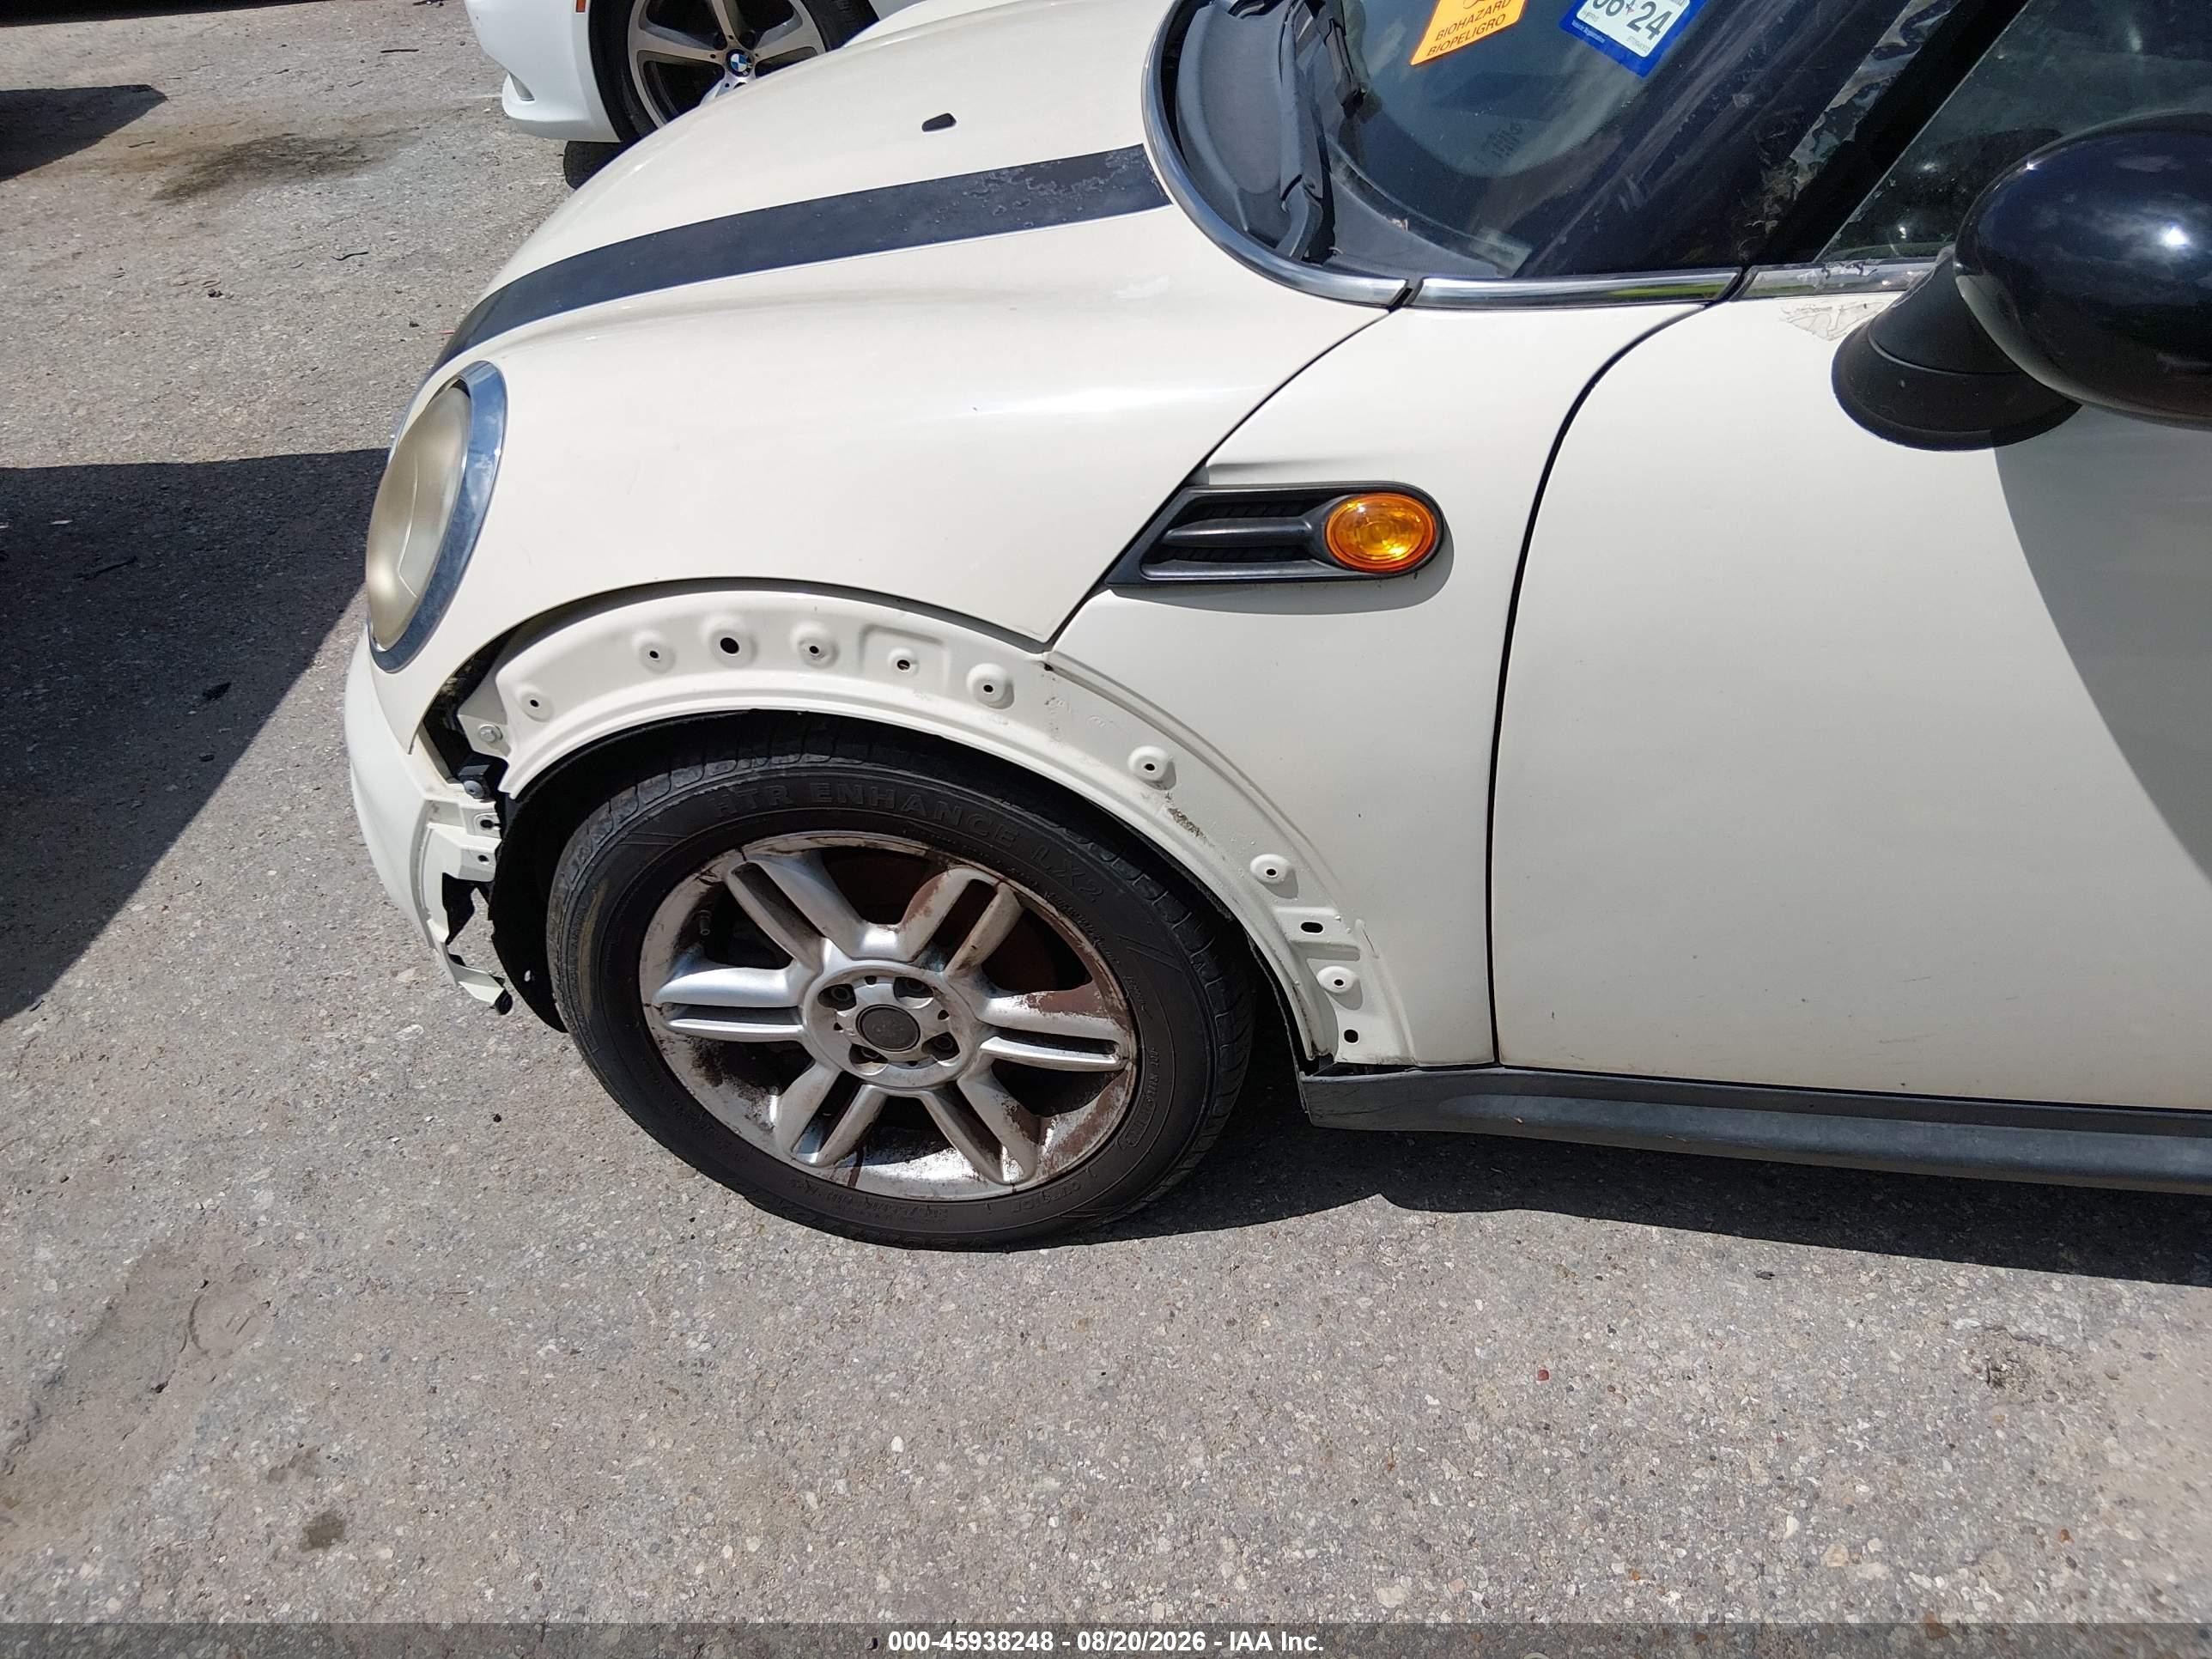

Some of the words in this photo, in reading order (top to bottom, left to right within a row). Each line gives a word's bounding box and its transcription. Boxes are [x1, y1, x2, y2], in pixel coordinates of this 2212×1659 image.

[1426, 14, 1506, 57] BIOPELIGRO
[1435, 0, 1511, 41] BIOHAZARD
[1626, 1, 1673, 40] 24
[810, 782, 1020, 848] ENHANCE
